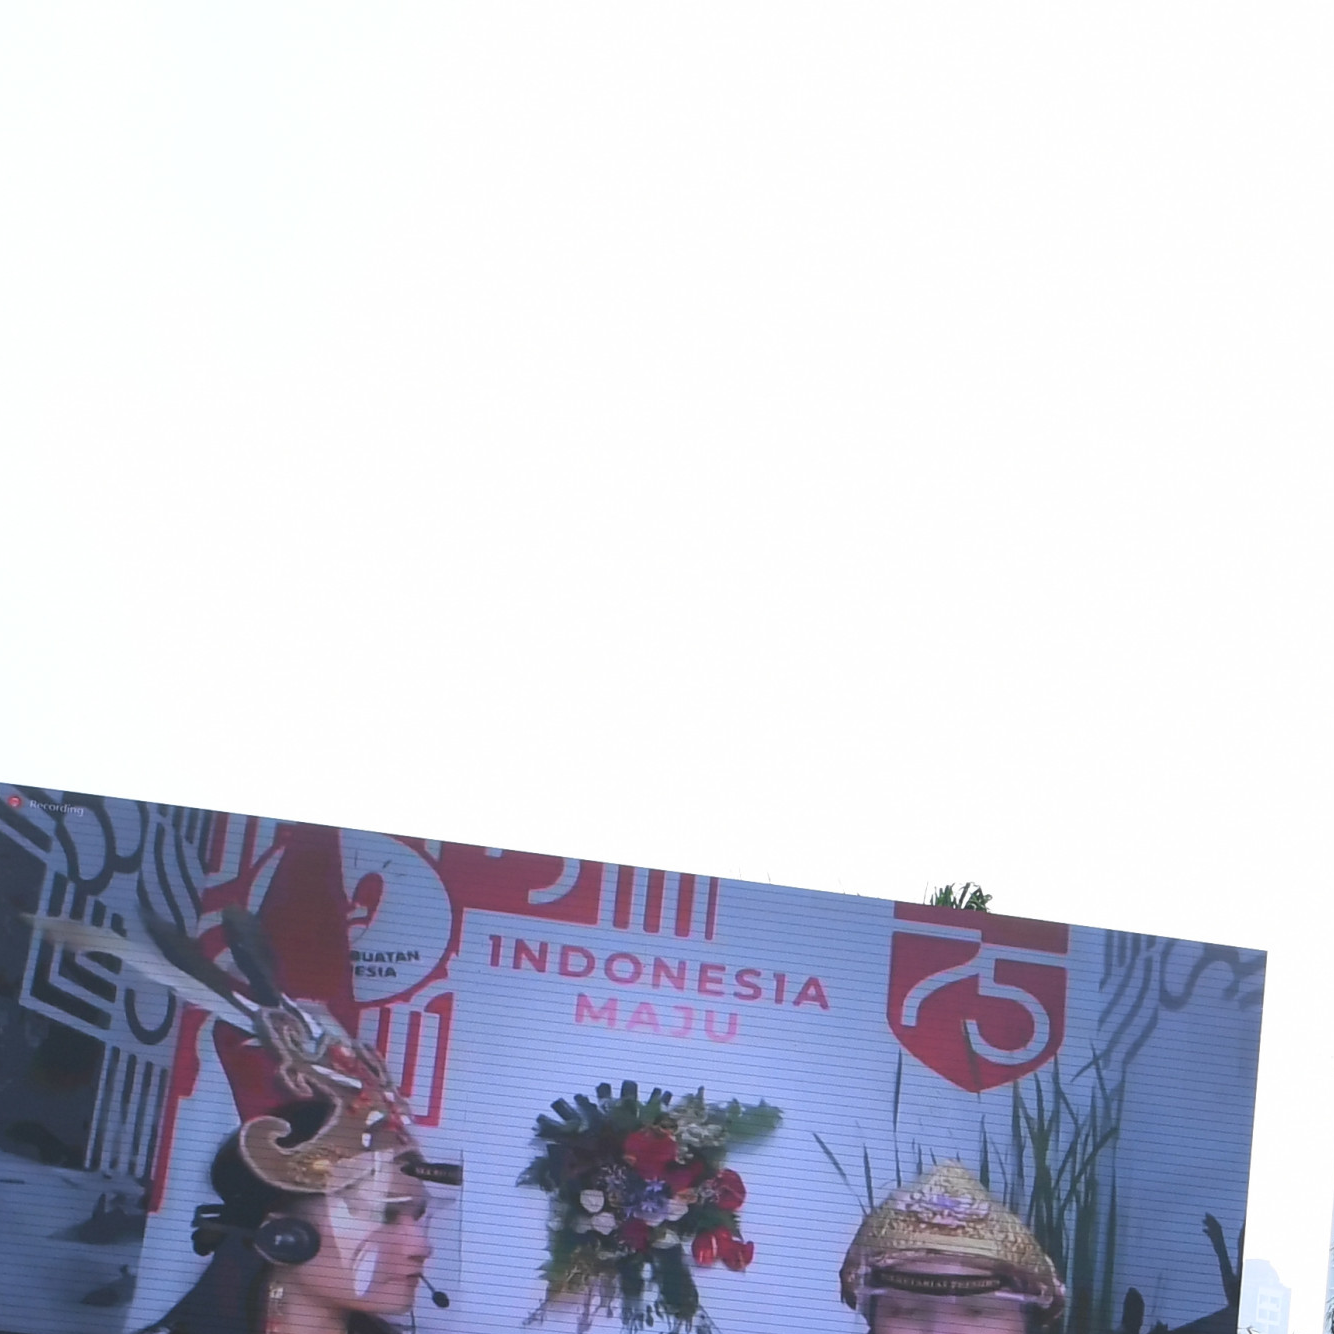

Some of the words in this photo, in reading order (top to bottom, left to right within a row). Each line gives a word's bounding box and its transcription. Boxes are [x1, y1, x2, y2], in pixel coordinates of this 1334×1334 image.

[29, 799, 85, 817] Recording
[354, 964, 397, 978] ESIA
[488, 933, 831, 1011] INDONESIA
[573, 992, 740, 1044] MAJU
